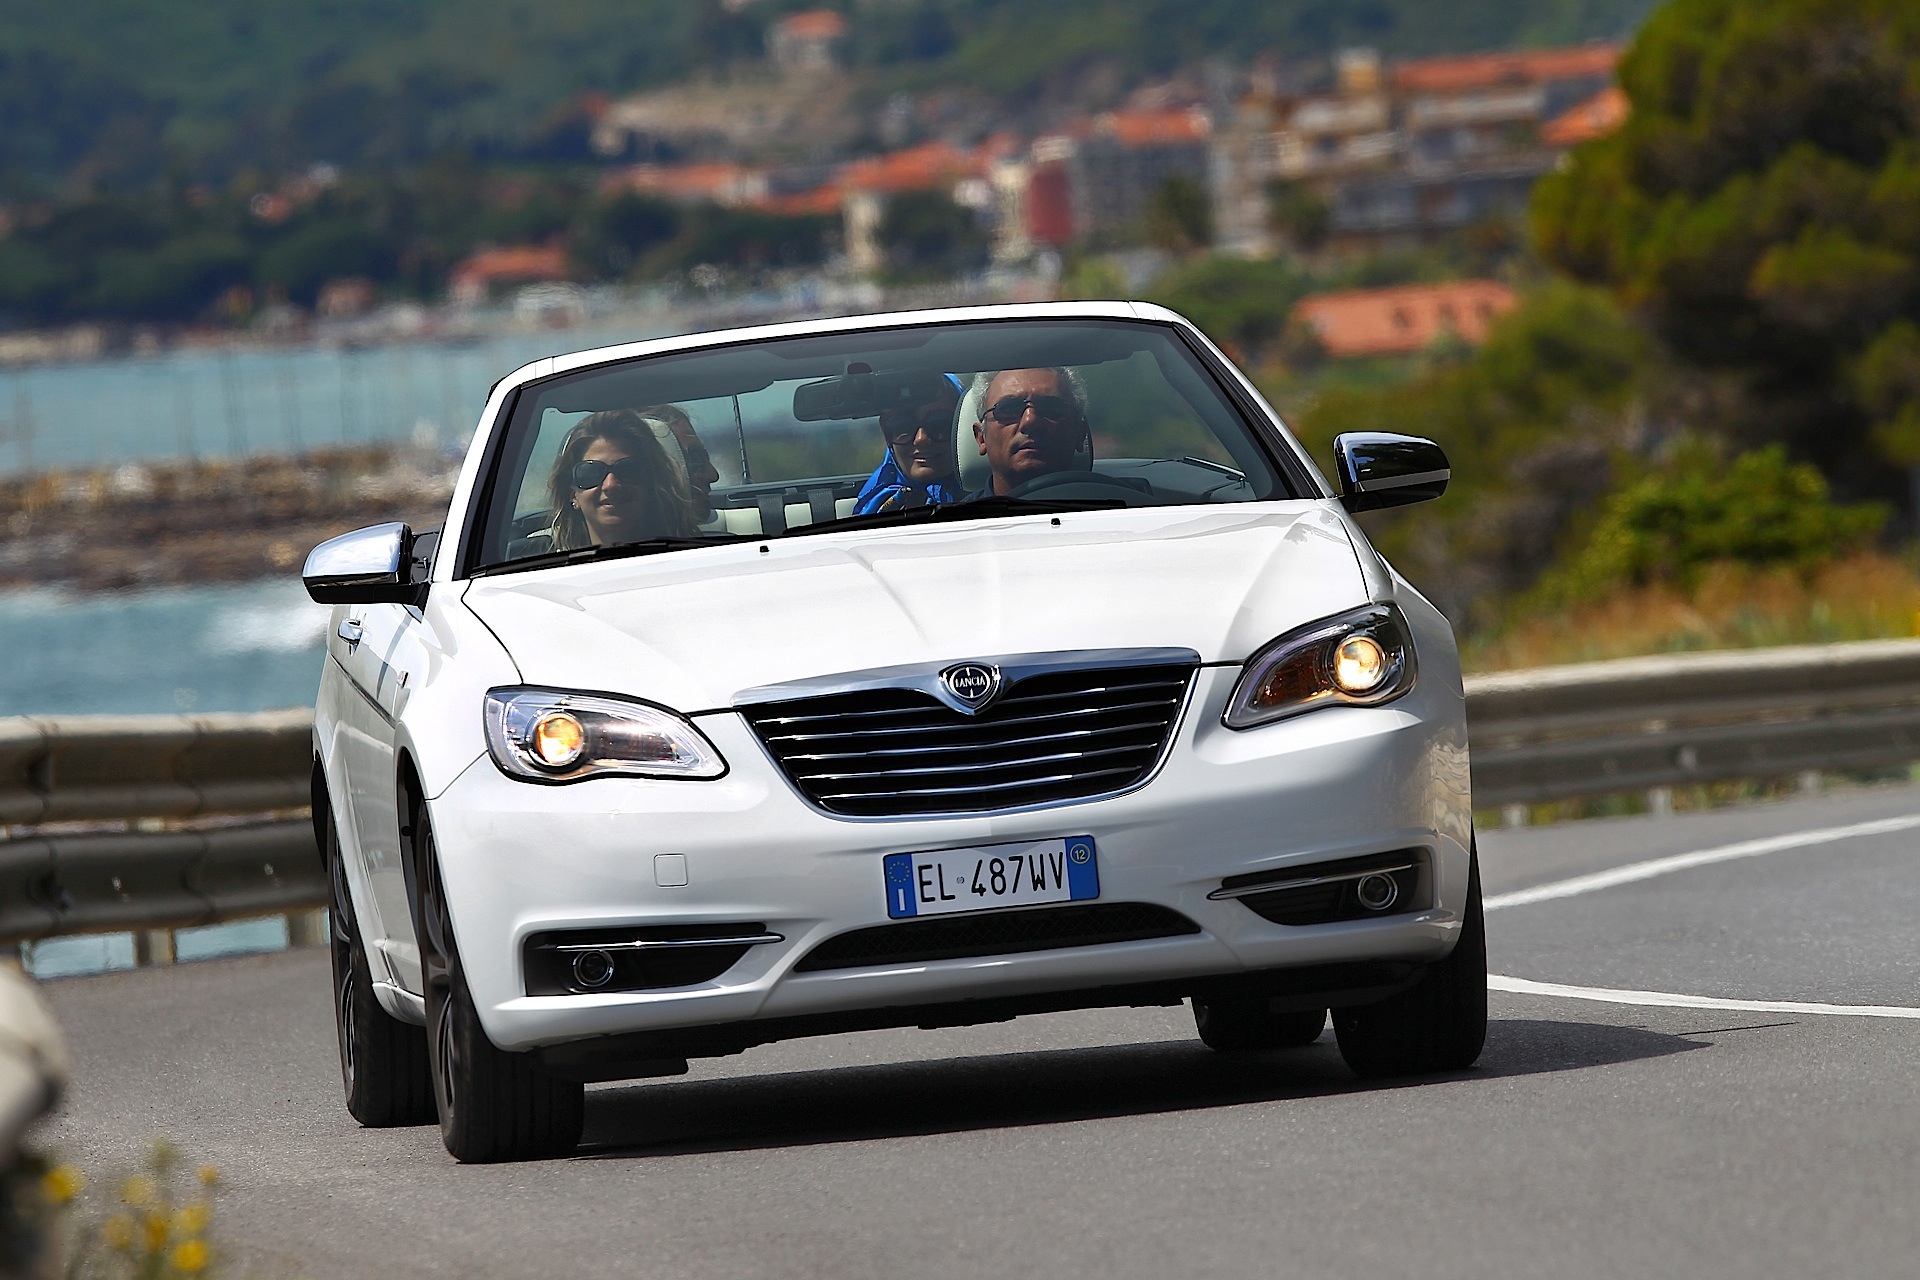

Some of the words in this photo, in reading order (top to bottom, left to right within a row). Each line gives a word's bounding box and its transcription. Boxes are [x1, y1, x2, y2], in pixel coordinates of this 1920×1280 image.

[955, 675, 986, 688] LANCIA
[1074, 849, 1086, 861] 12
[917, 864, 956, 903] EL
[970, 852, 1064, 898] 487WV
